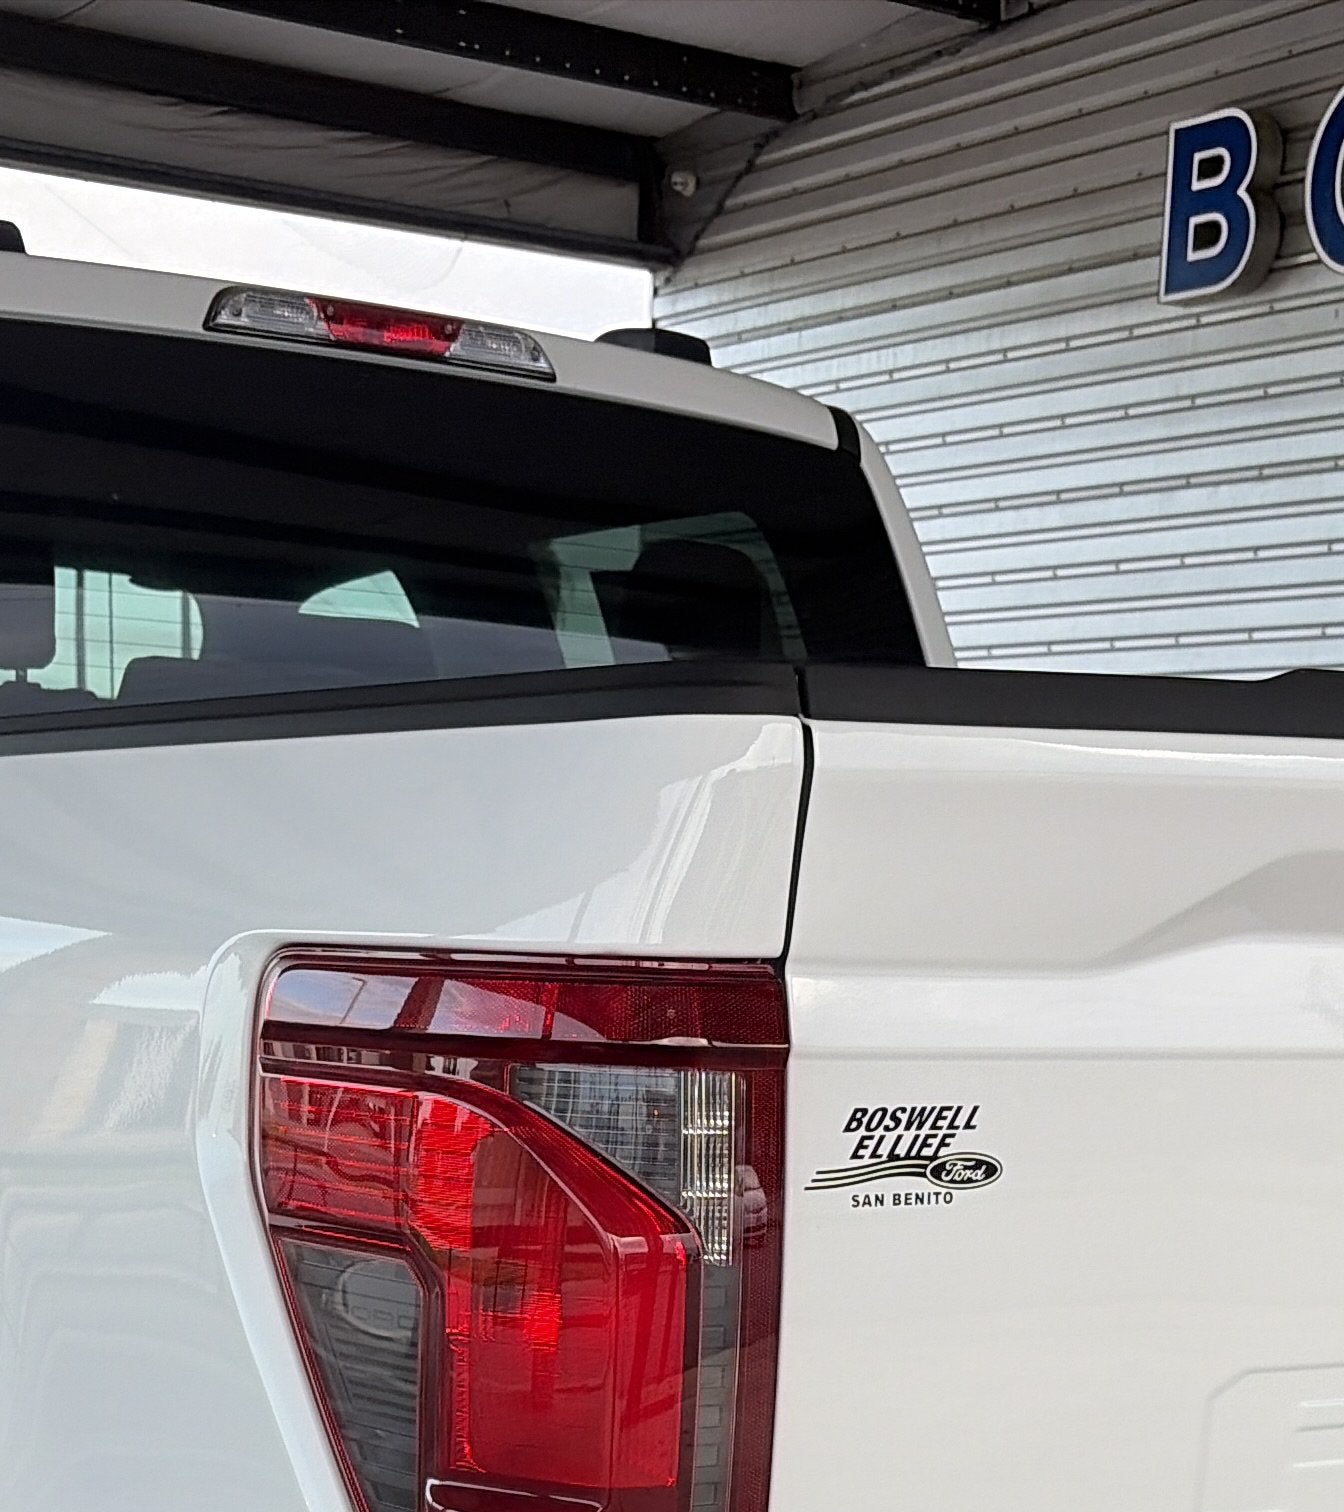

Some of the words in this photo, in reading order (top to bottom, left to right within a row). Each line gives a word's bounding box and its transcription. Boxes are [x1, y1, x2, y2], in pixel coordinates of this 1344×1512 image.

[843, 1105, 981, 1133] BOSWELL
[849, 1133, 957, 1160] ELLIFF
[941, 1160, 986, 1182] Ford
[851, 1194, 885, 1208] SAN
[892, 1191, 954, 1206] BENITO
